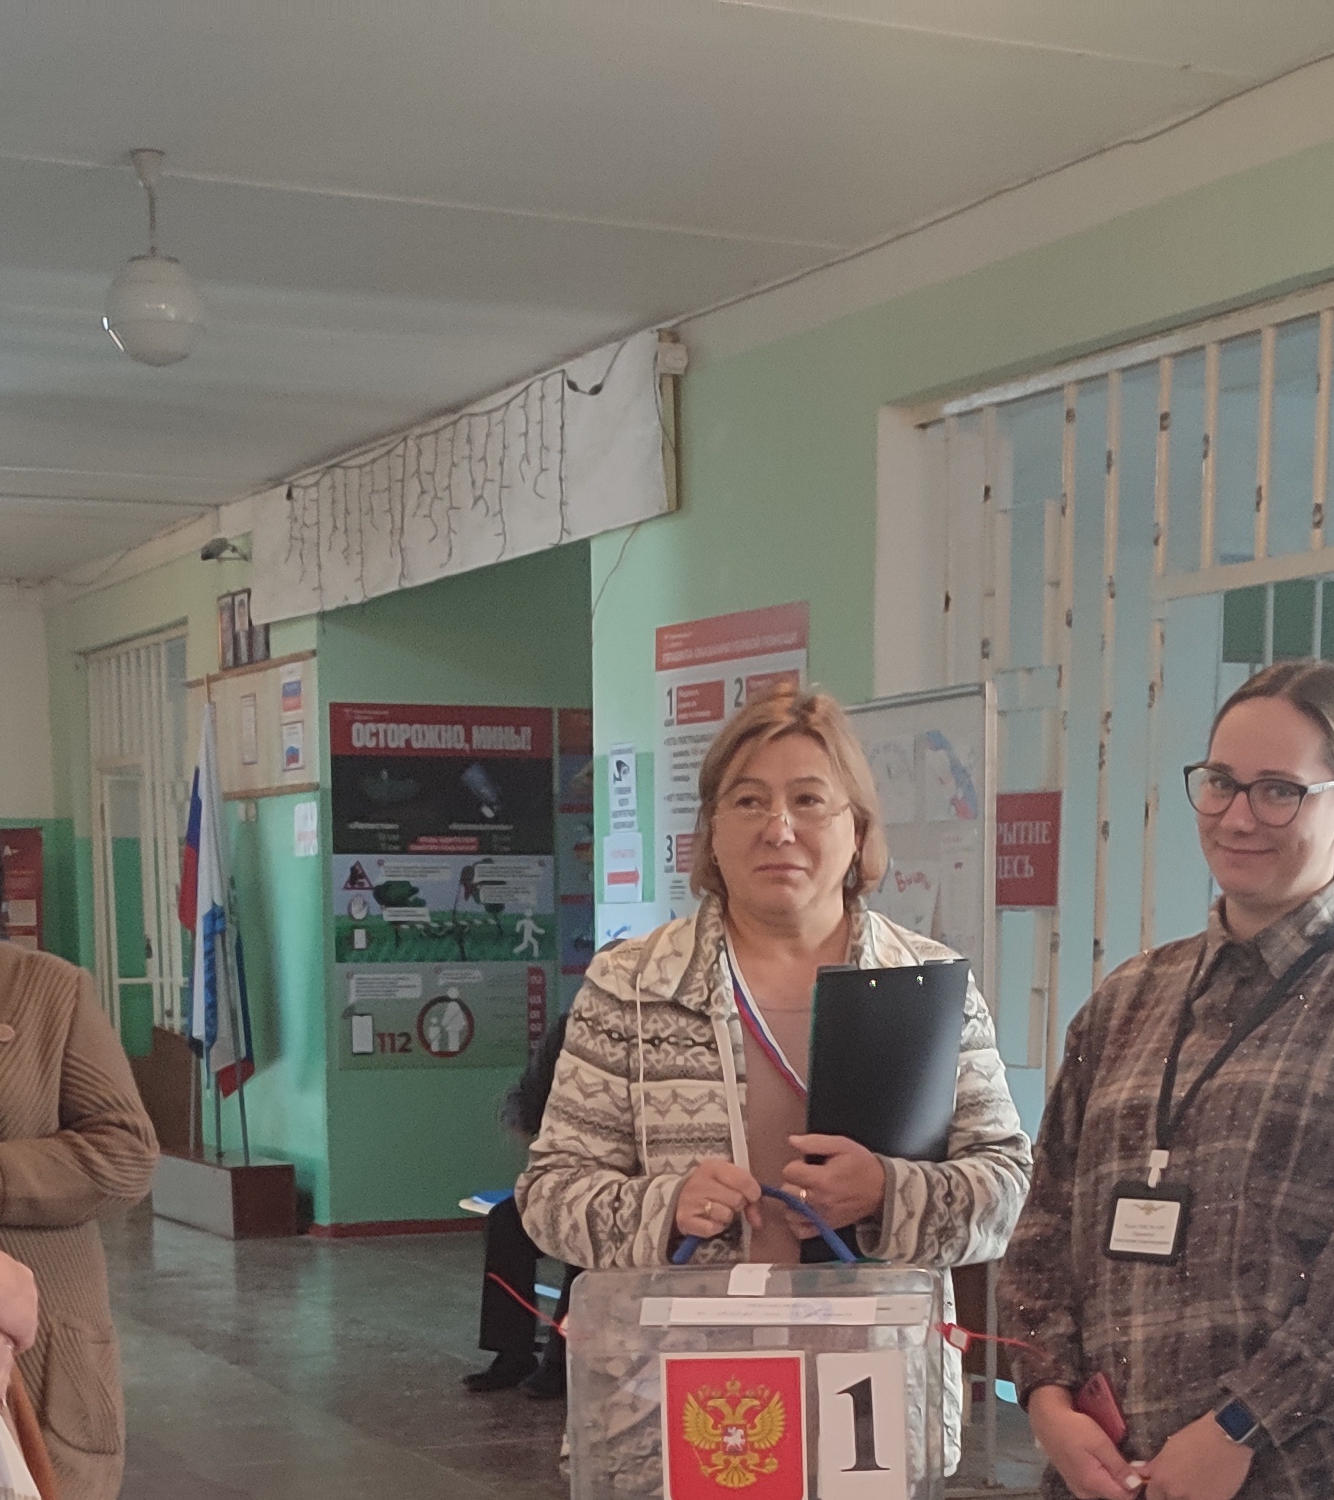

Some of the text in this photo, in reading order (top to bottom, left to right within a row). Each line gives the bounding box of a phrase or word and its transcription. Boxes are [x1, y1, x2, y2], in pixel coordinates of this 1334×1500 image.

[666, 687, 673, 716] 1
[734, 677, 744, 708] 2
[351, 722, 469, 752] ОСТОРОЖНО,
[997, 821, 1051, 845] РЫТИЕ
[666, 835, 673, 863] 3
[997, 855, 1034, 879] ДЕСЬ
[376, 1031, 413, 1055] 112
[836, 1376, 890, 1472] 1
